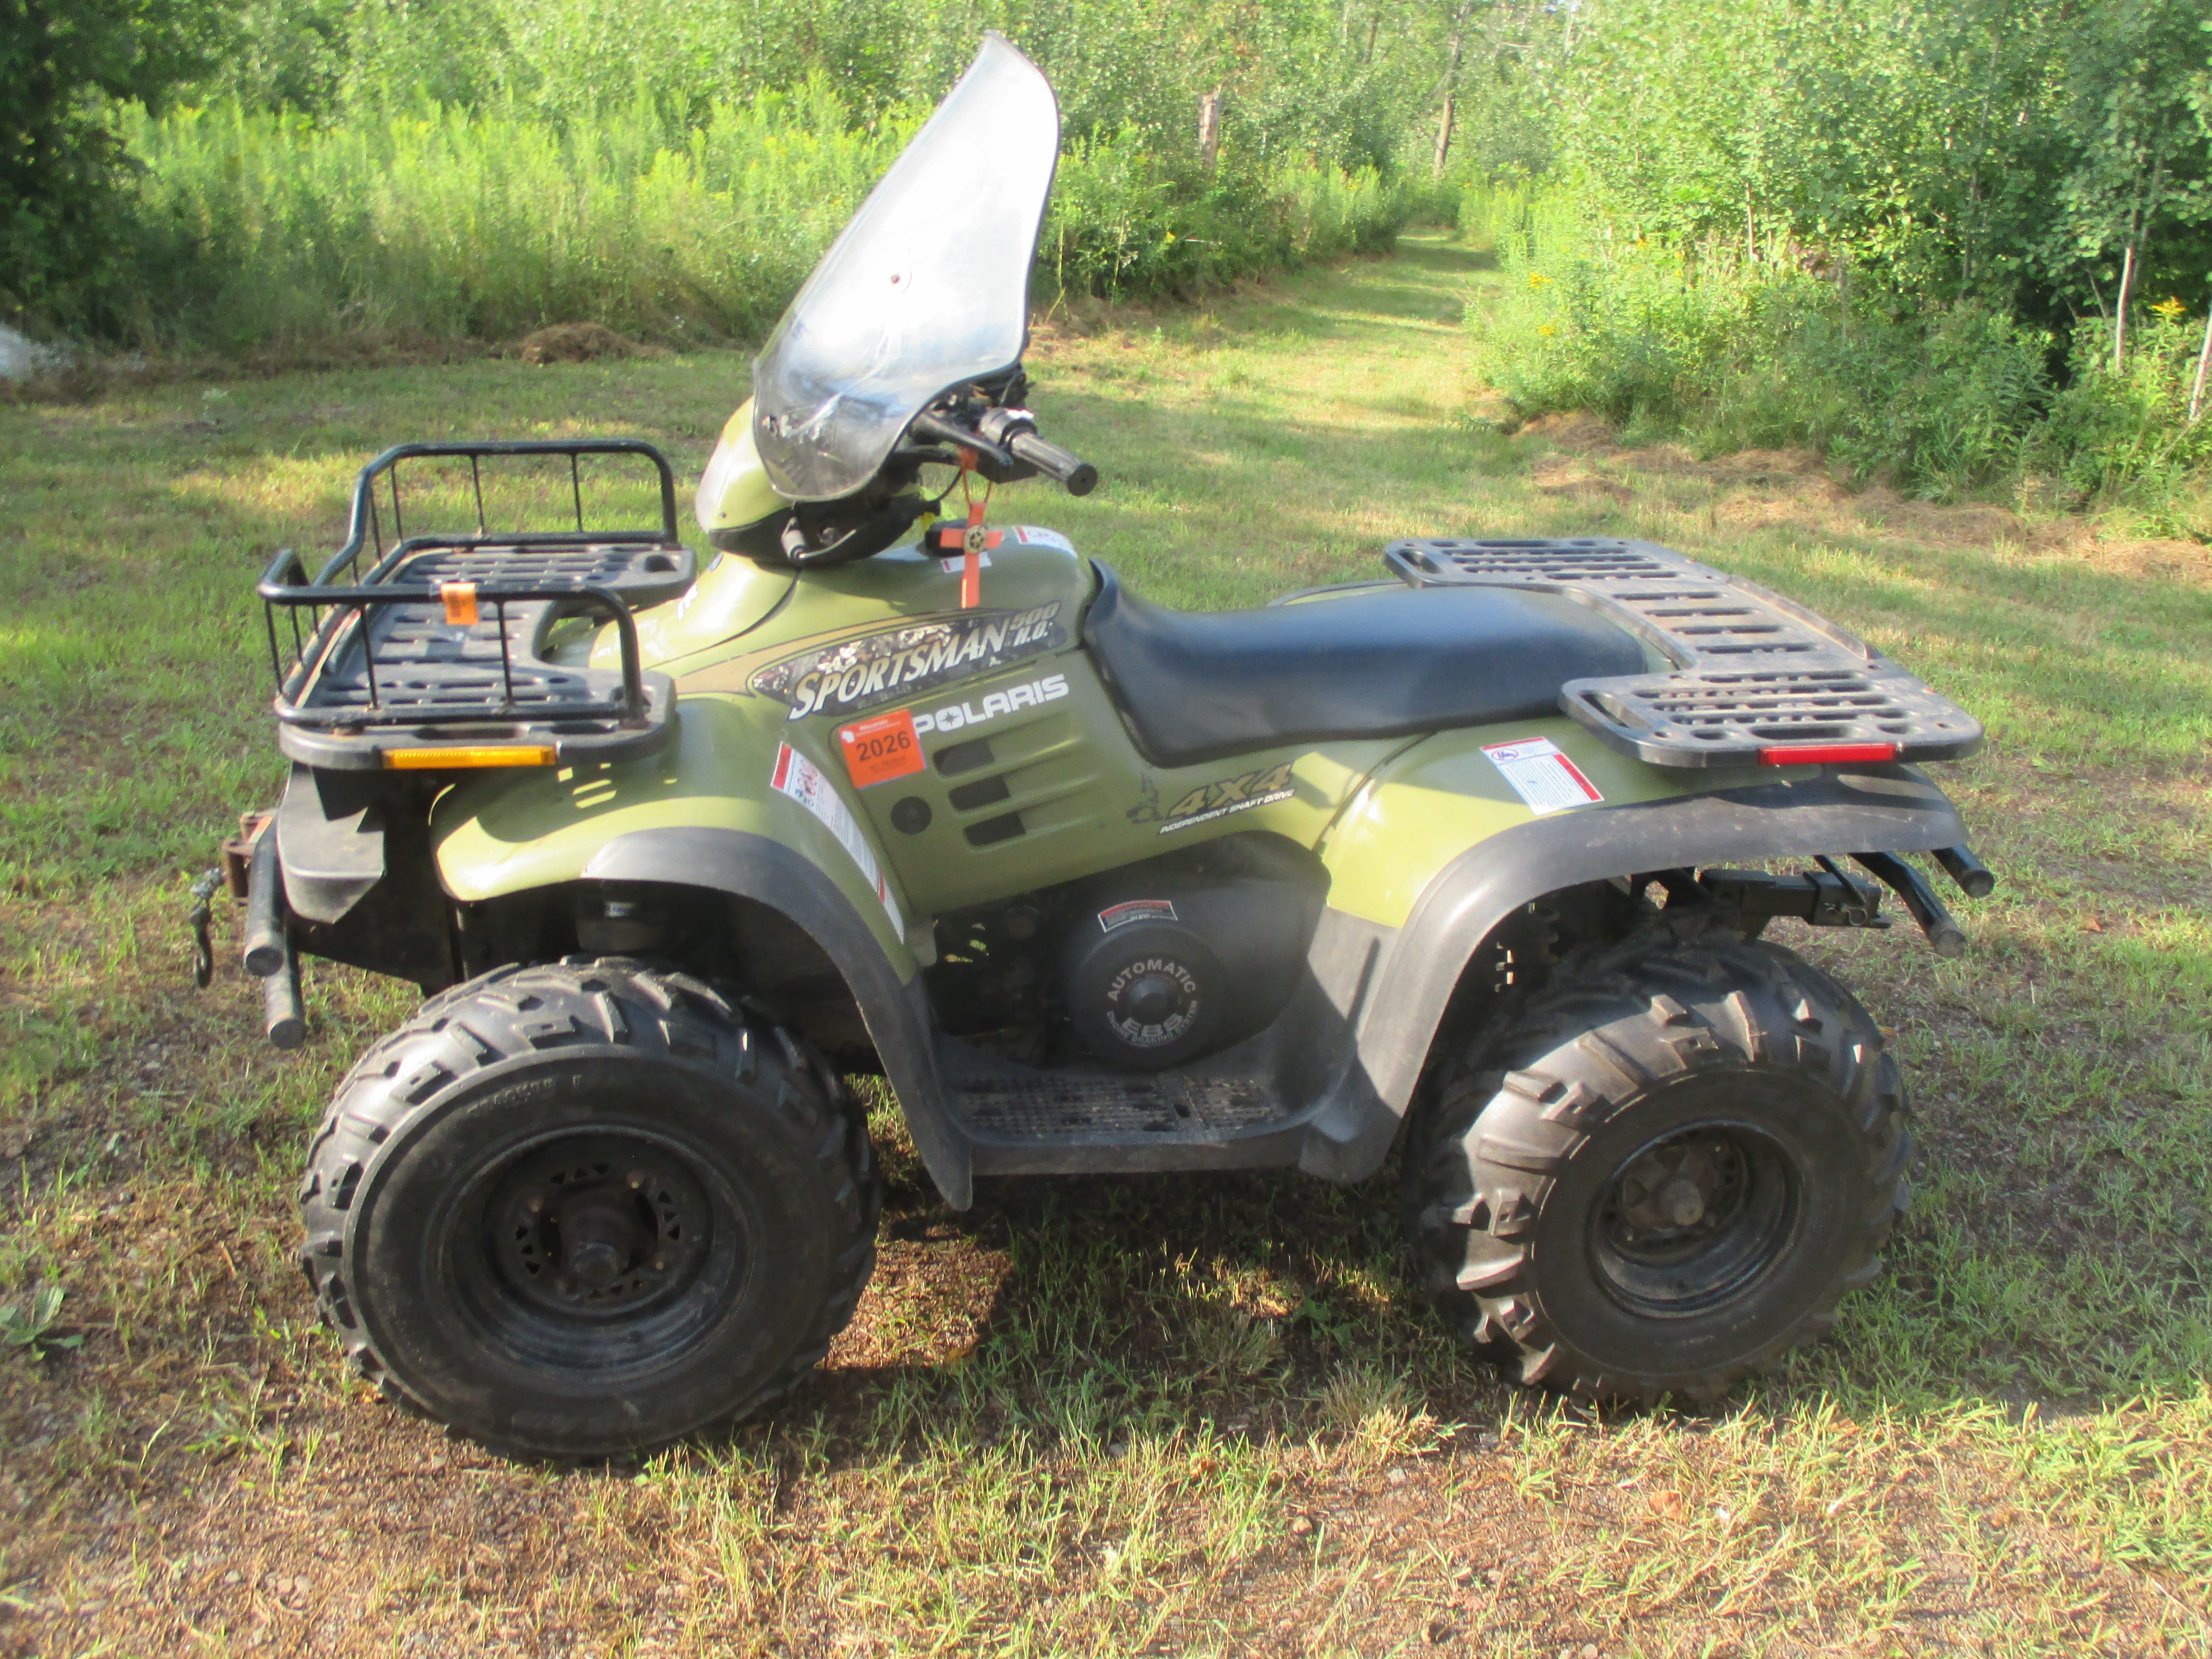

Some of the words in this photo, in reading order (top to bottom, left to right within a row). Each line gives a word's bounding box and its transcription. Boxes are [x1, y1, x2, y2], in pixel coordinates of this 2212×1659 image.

[789, 618, 1010, 720] SPORTSMAN
[913, 673, 1069, 740] POLARIS
[856, 731, 911, 761] 2026
[1159, 807, 1228, 835] INDEPENDENT
[1263, 788, 1295, 804] DRIVE
[1107, 958, 1196, 1001] AUTOMATIC
